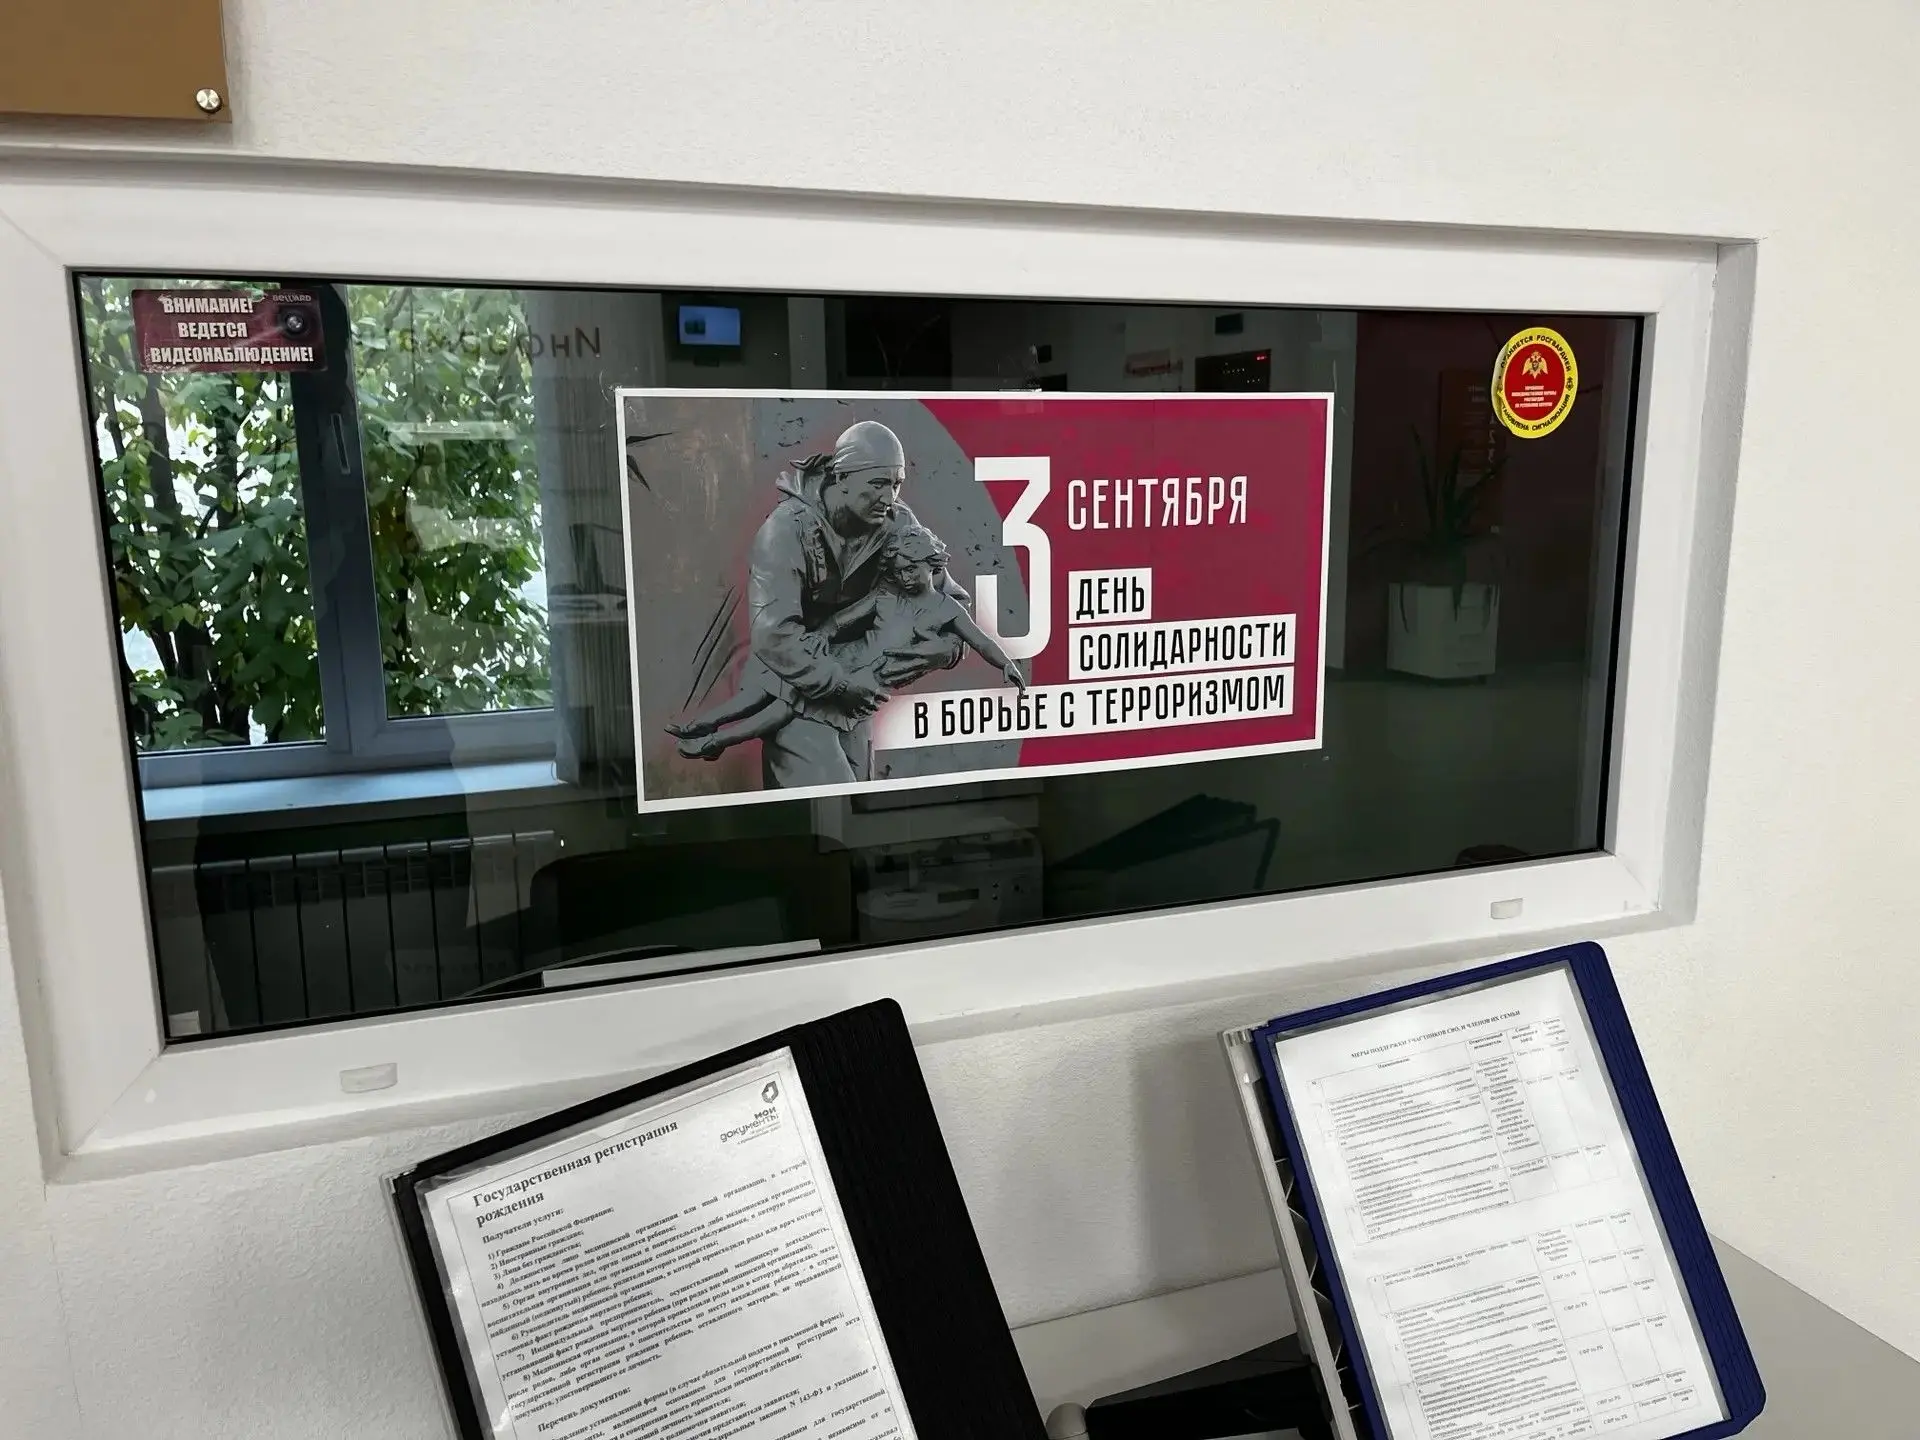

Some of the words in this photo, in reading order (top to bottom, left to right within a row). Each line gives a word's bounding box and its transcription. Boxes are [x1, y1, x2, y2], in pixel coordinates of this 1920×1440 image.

[164, 297, 253, 313] ВНИМАНИЕ!
[177, 322, 248, 340] ВЕДЕТСЯ
[150, 346, 314, 365] ВИДЕОНАБЛЮДЕНИЕ!
[974, 456, 1052, 659] 3
[1067, 475, 1247, 530] СЕНТЯБРЯ
[1076, 575, 1146, 620] ДЕНЬ
[1079, 621, 1287, 672] СОЛИДАРНОСТИ
[913, 701, 930, 739] В
[941, 693, 1048, 737] БОРЬБЕ
[1060, 691, 1075, 729] С
[1087, 674, 1286, 726] ТЕРРОРИЗМОМ
[754, 1107, 776, 1119] мои
[472, 1154, 591, 1207] Государственная
[594, 1121, 678, 1163] регистрация
[475, 1192, 544, 1228] рождения
[482, 1220, 532, 1244] Получатели
[532, 1208, 563, 1225] услуги:
[537, 1410, 578, 1432] Перечень
[579, 1386, 630, 1414] документов:
